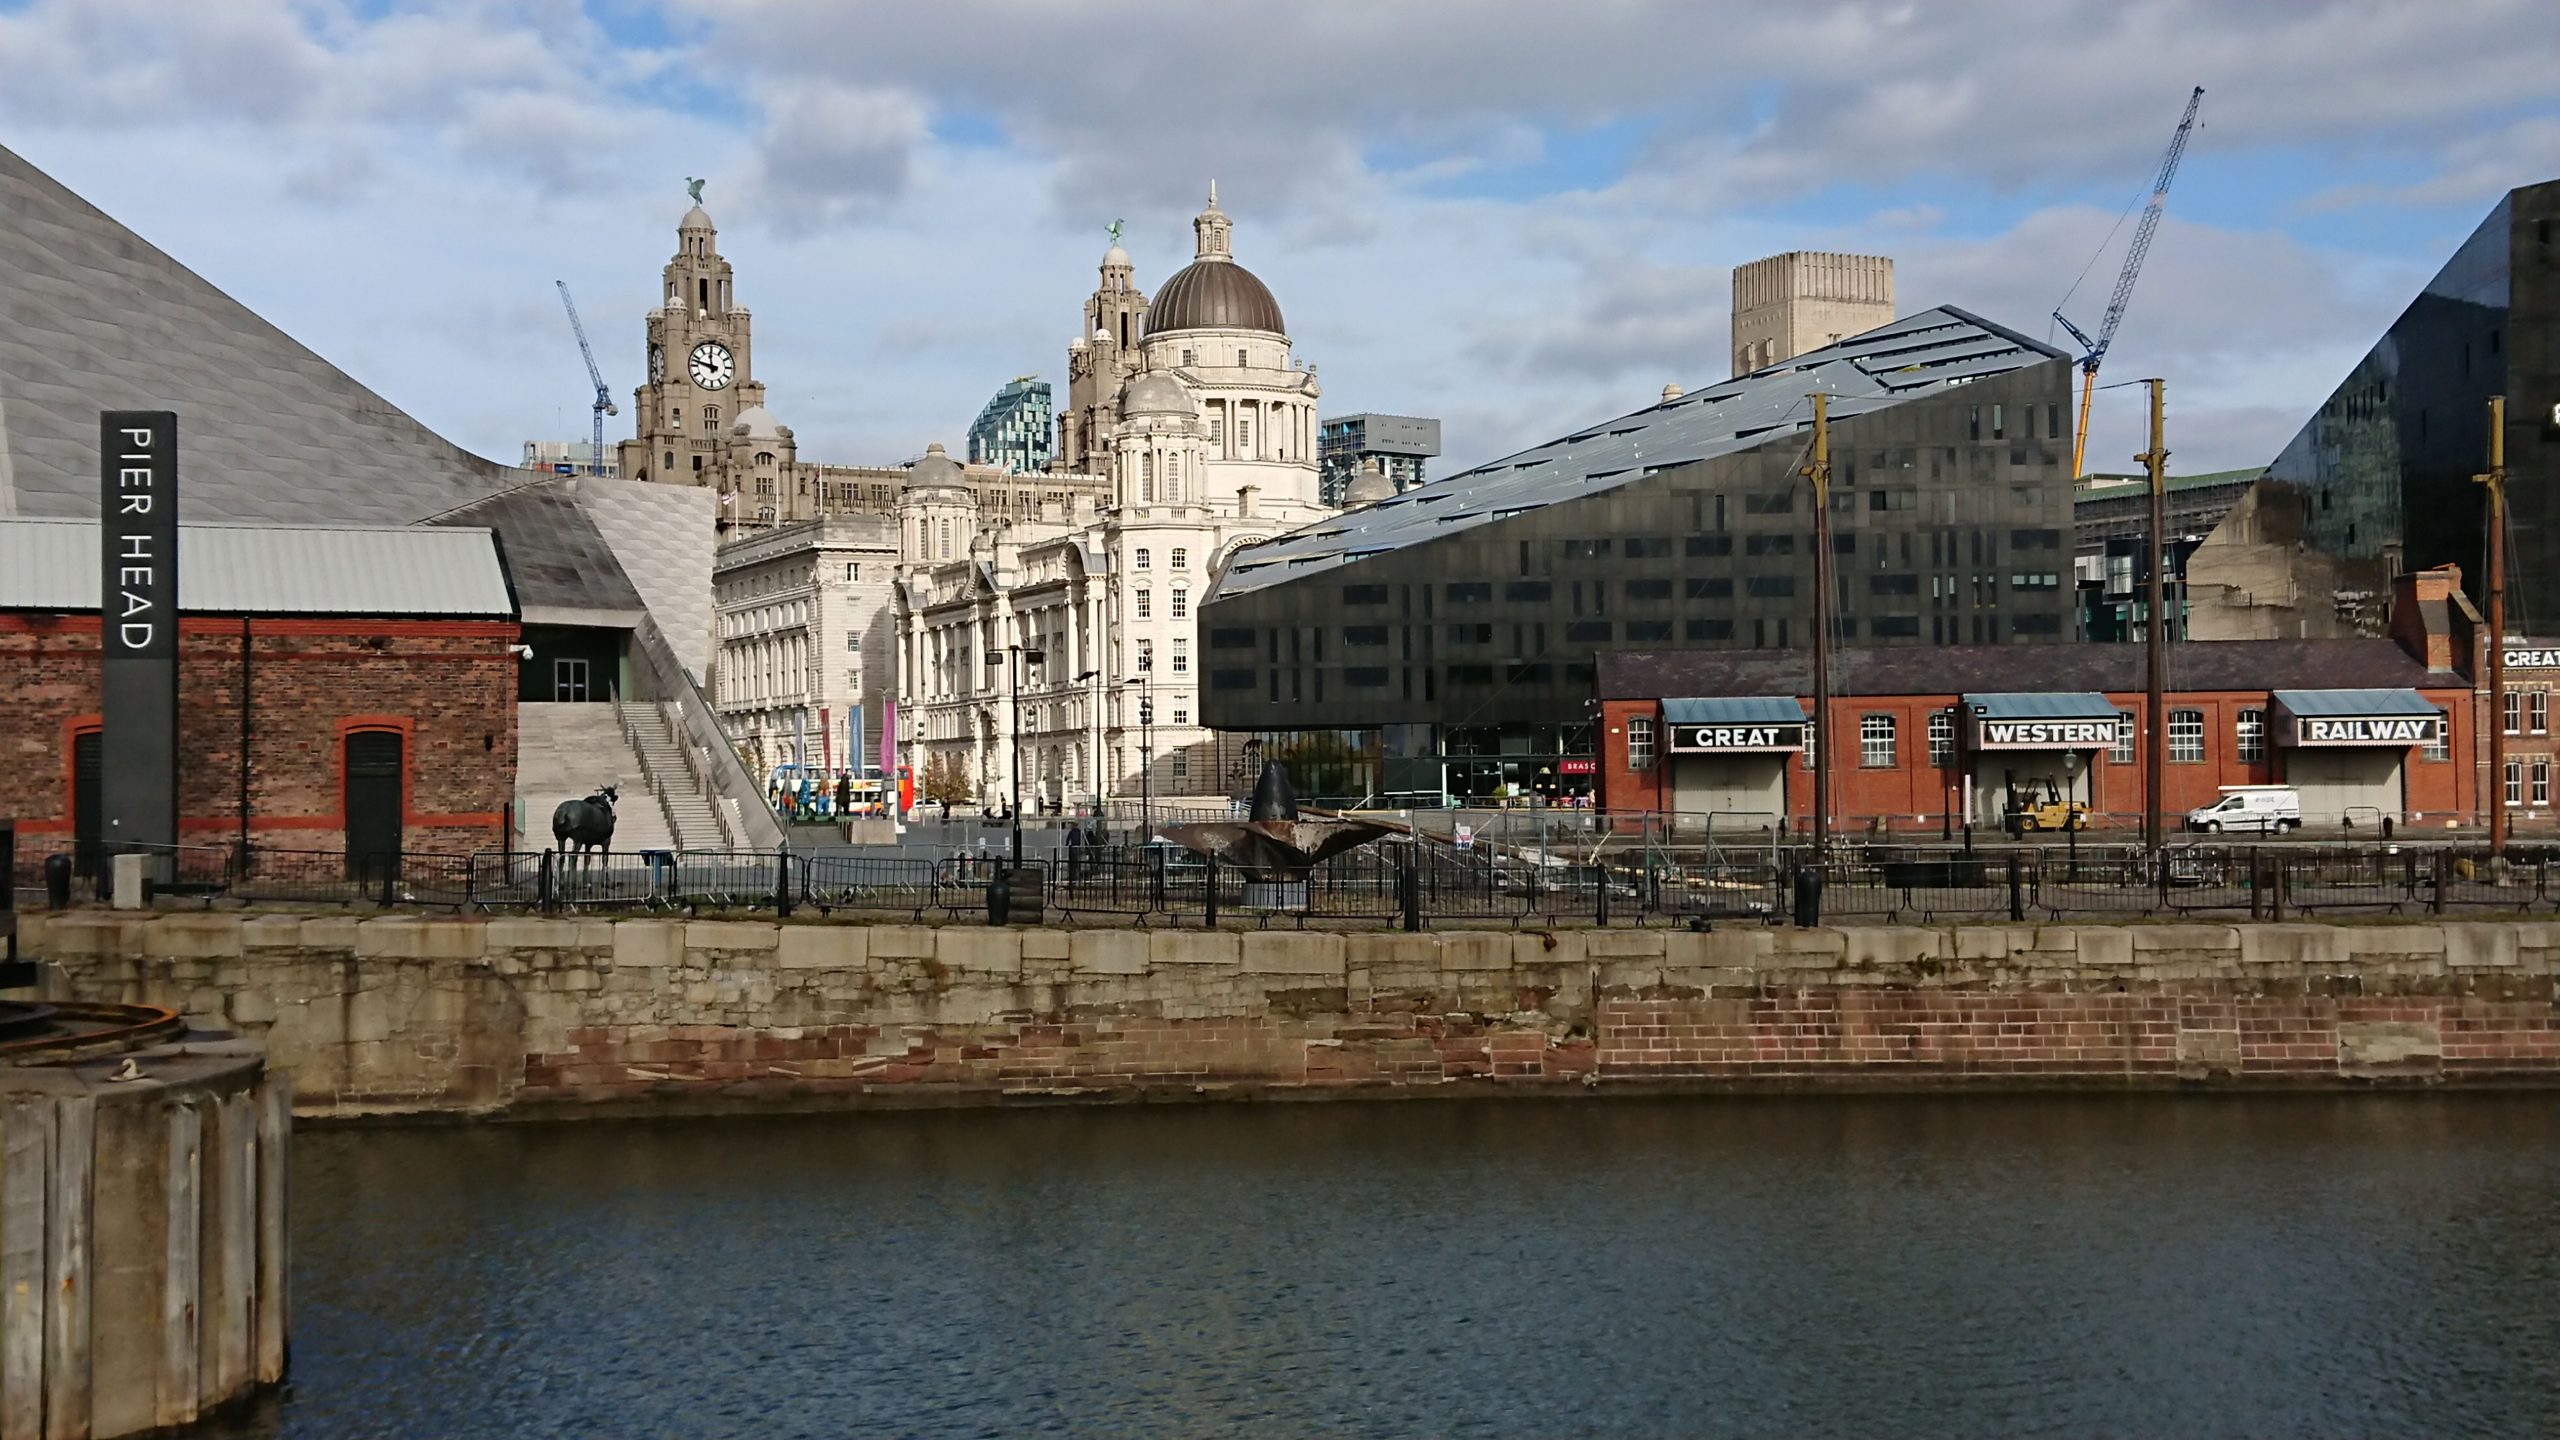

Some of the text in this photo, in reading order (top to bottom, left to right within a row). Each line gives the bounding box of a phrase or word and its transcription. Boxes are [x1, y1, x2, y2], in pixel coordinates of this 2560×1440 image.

[120, 428, 152, 648] PIER HEAD
[1695, 728, 1779, 747] GREAT
[1989, 724, 2112, 743] WESTERN
[2311, 720, 2427, 740] RAILWAY
